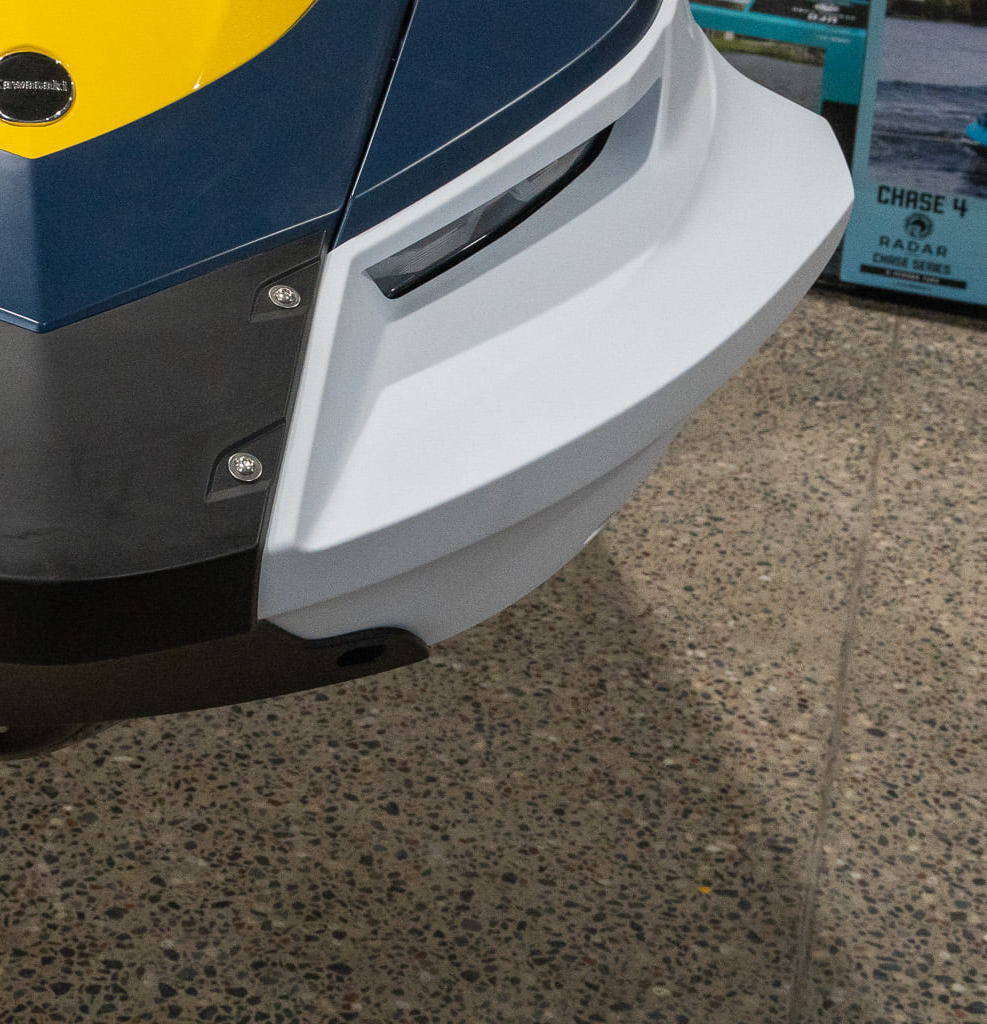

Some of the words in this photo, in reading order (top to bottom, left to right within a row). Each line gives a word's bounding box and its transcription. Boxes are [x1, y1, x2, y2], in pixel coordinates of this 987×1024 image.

[877, 184, 946, 214] CHASE
[953, 198, 968, 218] 4
[879, 235, 948, 257] RADAR
